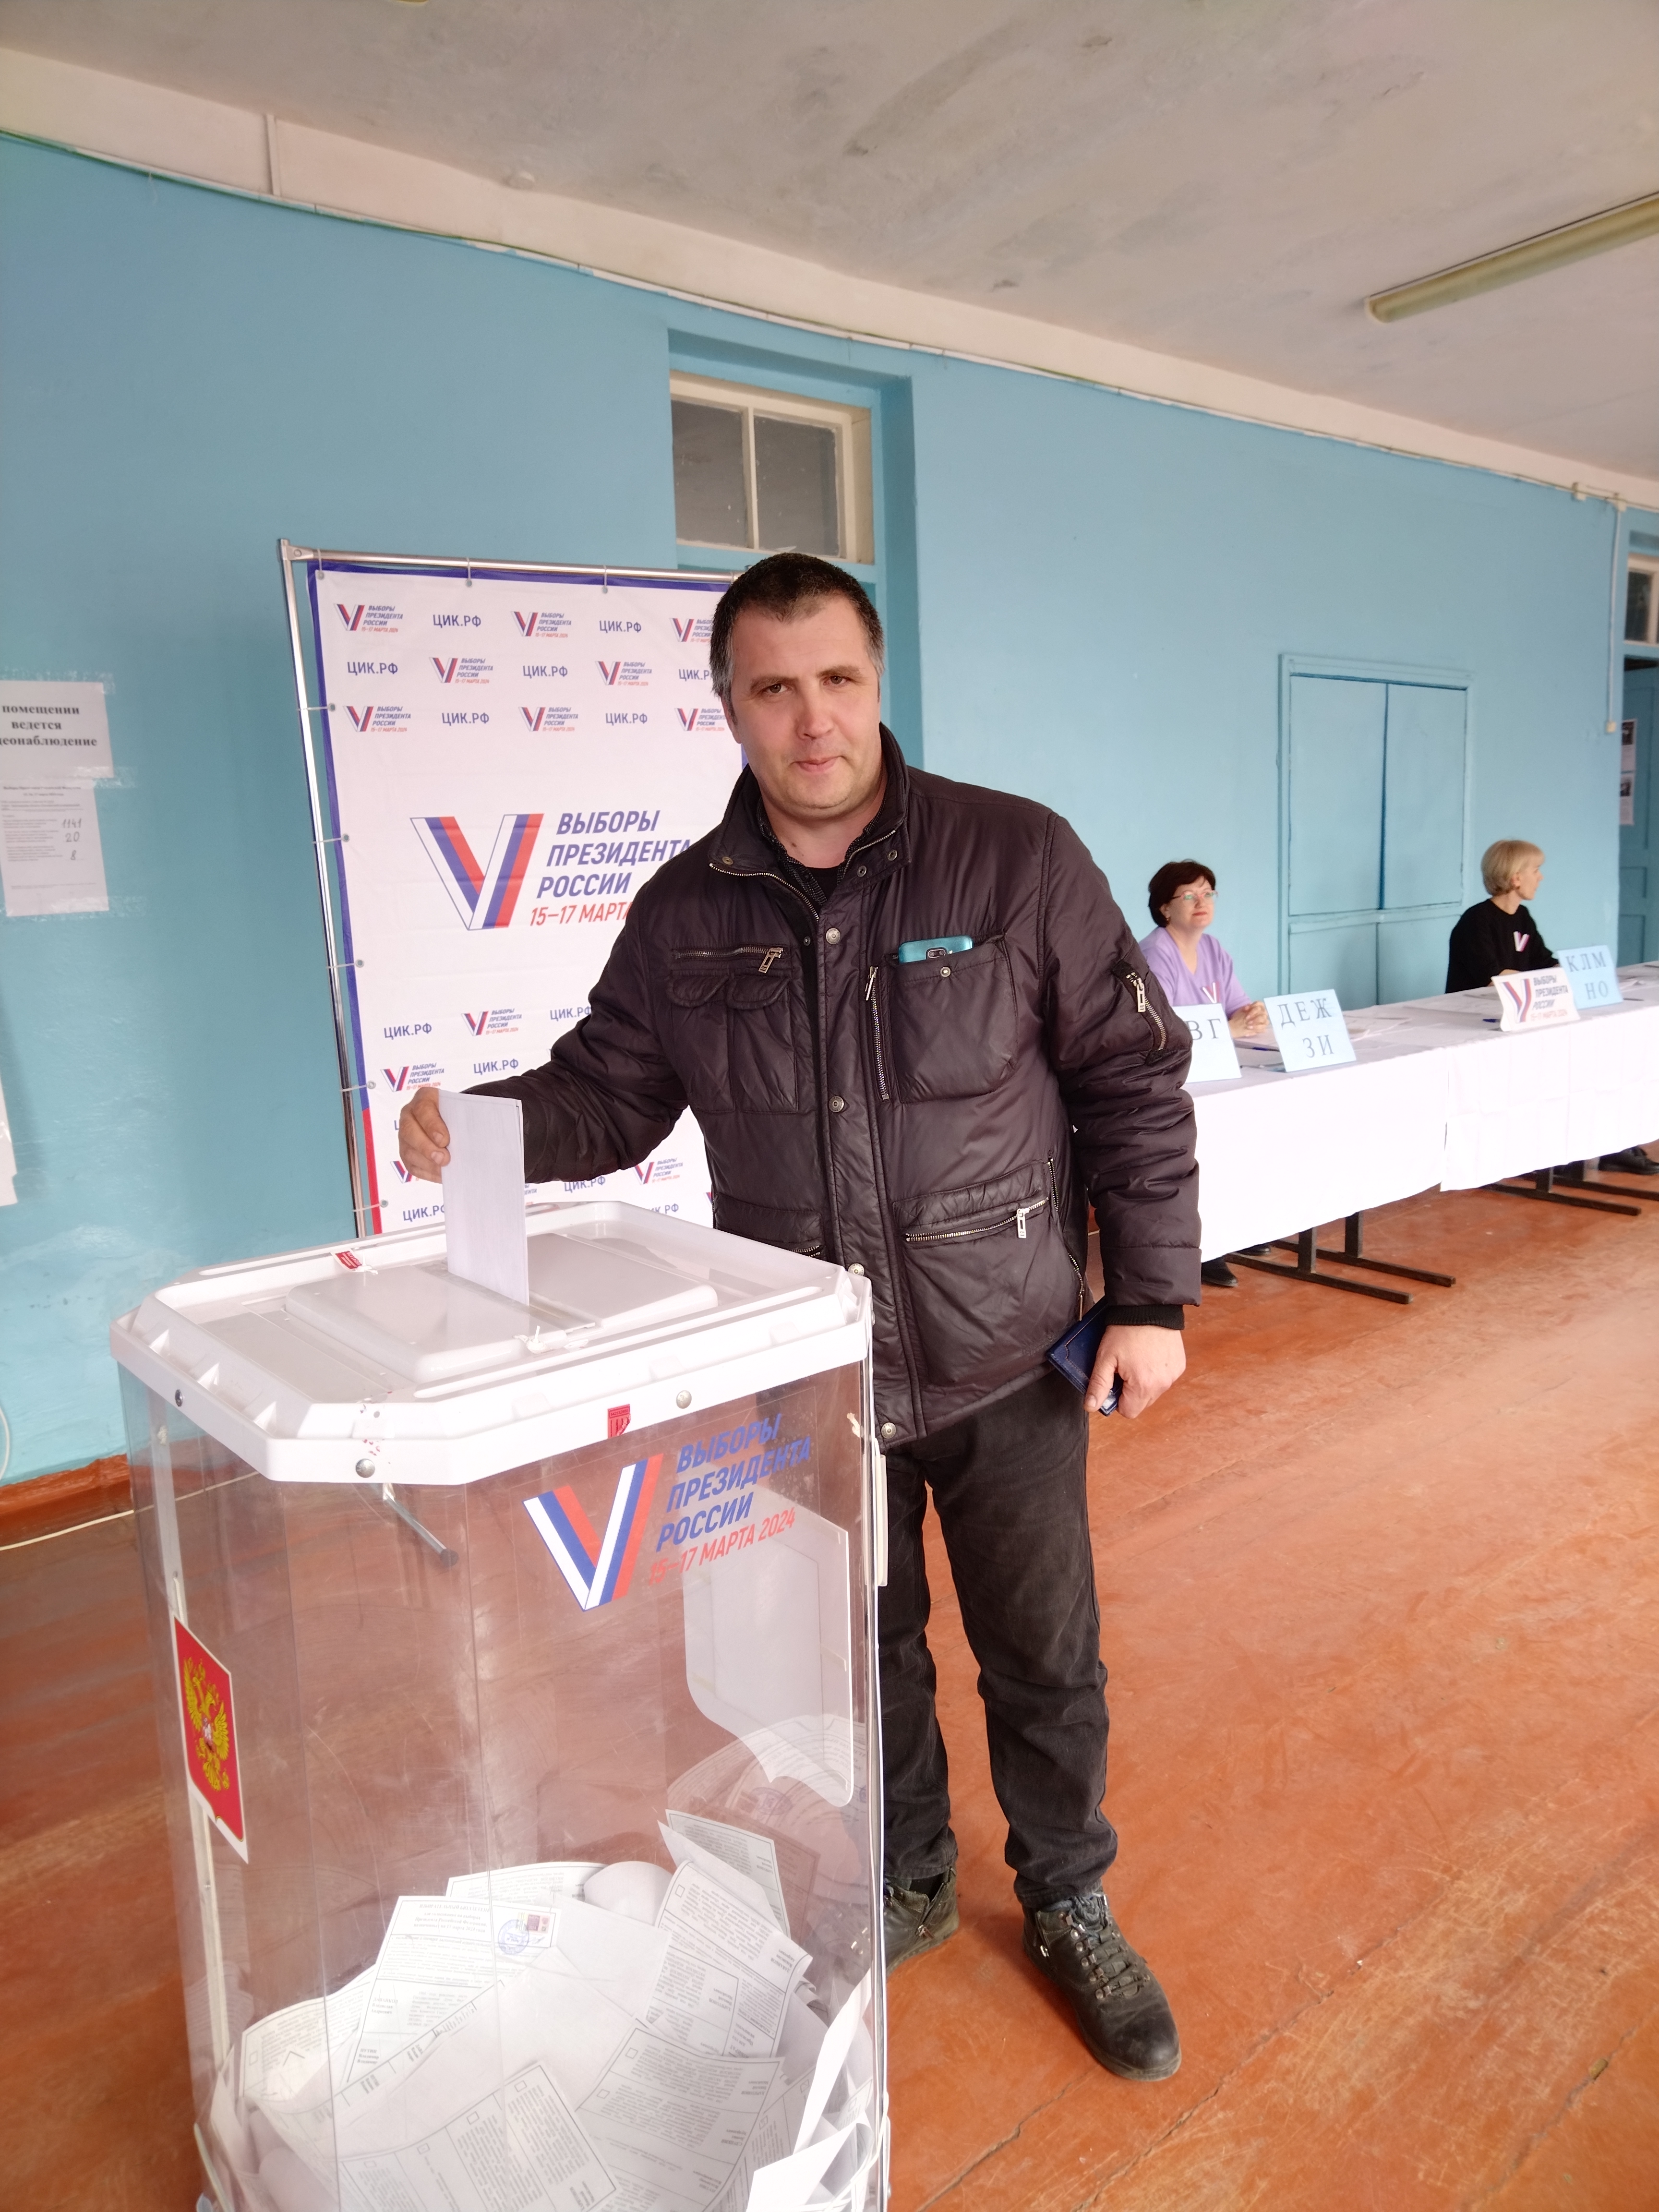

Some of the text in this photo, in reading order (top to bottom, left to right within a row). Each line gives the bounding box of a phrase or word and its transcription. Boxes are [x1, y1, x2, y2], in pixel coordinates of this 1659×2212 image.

[433, 614, 481, 628] ЦИК.РФ
[599, 620, 642, 633] ЦИК.РФ
[347, 661, 398, 676] ЦИК.РФ
[523, 665, 568, 679] ЦИК.РФ
[679, 669, 712, 682] ЦИК.Р
[2, 705, 80, 715] помещении
[12, 721, 62, 730] ведется
[442, 712, 489, 726] ЦИК.РФ
[605, 712, 648, 726] ЦИК.РФ
[556, 810, 660, 835] ВЫБОРЫ
[65, 831, 80, 842] 20
[537, 872, 632, 899] РОССИИ
[1533, 974, 1557, 986] ВЫБОРЫ
[1535, 985, 1569, 998] ПРЕЗИДЕНТА
[1532, 999, 1555, 1010] РОССИИ
[489, 1014, 522, 1022] ПРЕЗИДЕНТА
[384, 1022, 432, 1040] ЦИК.РФ
[410, 1069, 445, 1077] ПРЕЗИДЕНТА
[412, 1062, 437, 1070] ВЫБОРЫ
[473, 1058, 519, 1075] ЦИК.РФ
[677, 1413, 782, 1474] ВЫБОРЫ
[666, 1436, 811, 1513] ПРЕЗИДЕНТА
[656, 1492, 754, 1552] РОССИИ
[698, 1526, 755, 1567] МАРТА
[757, 1507, 795, 1542] 2024
